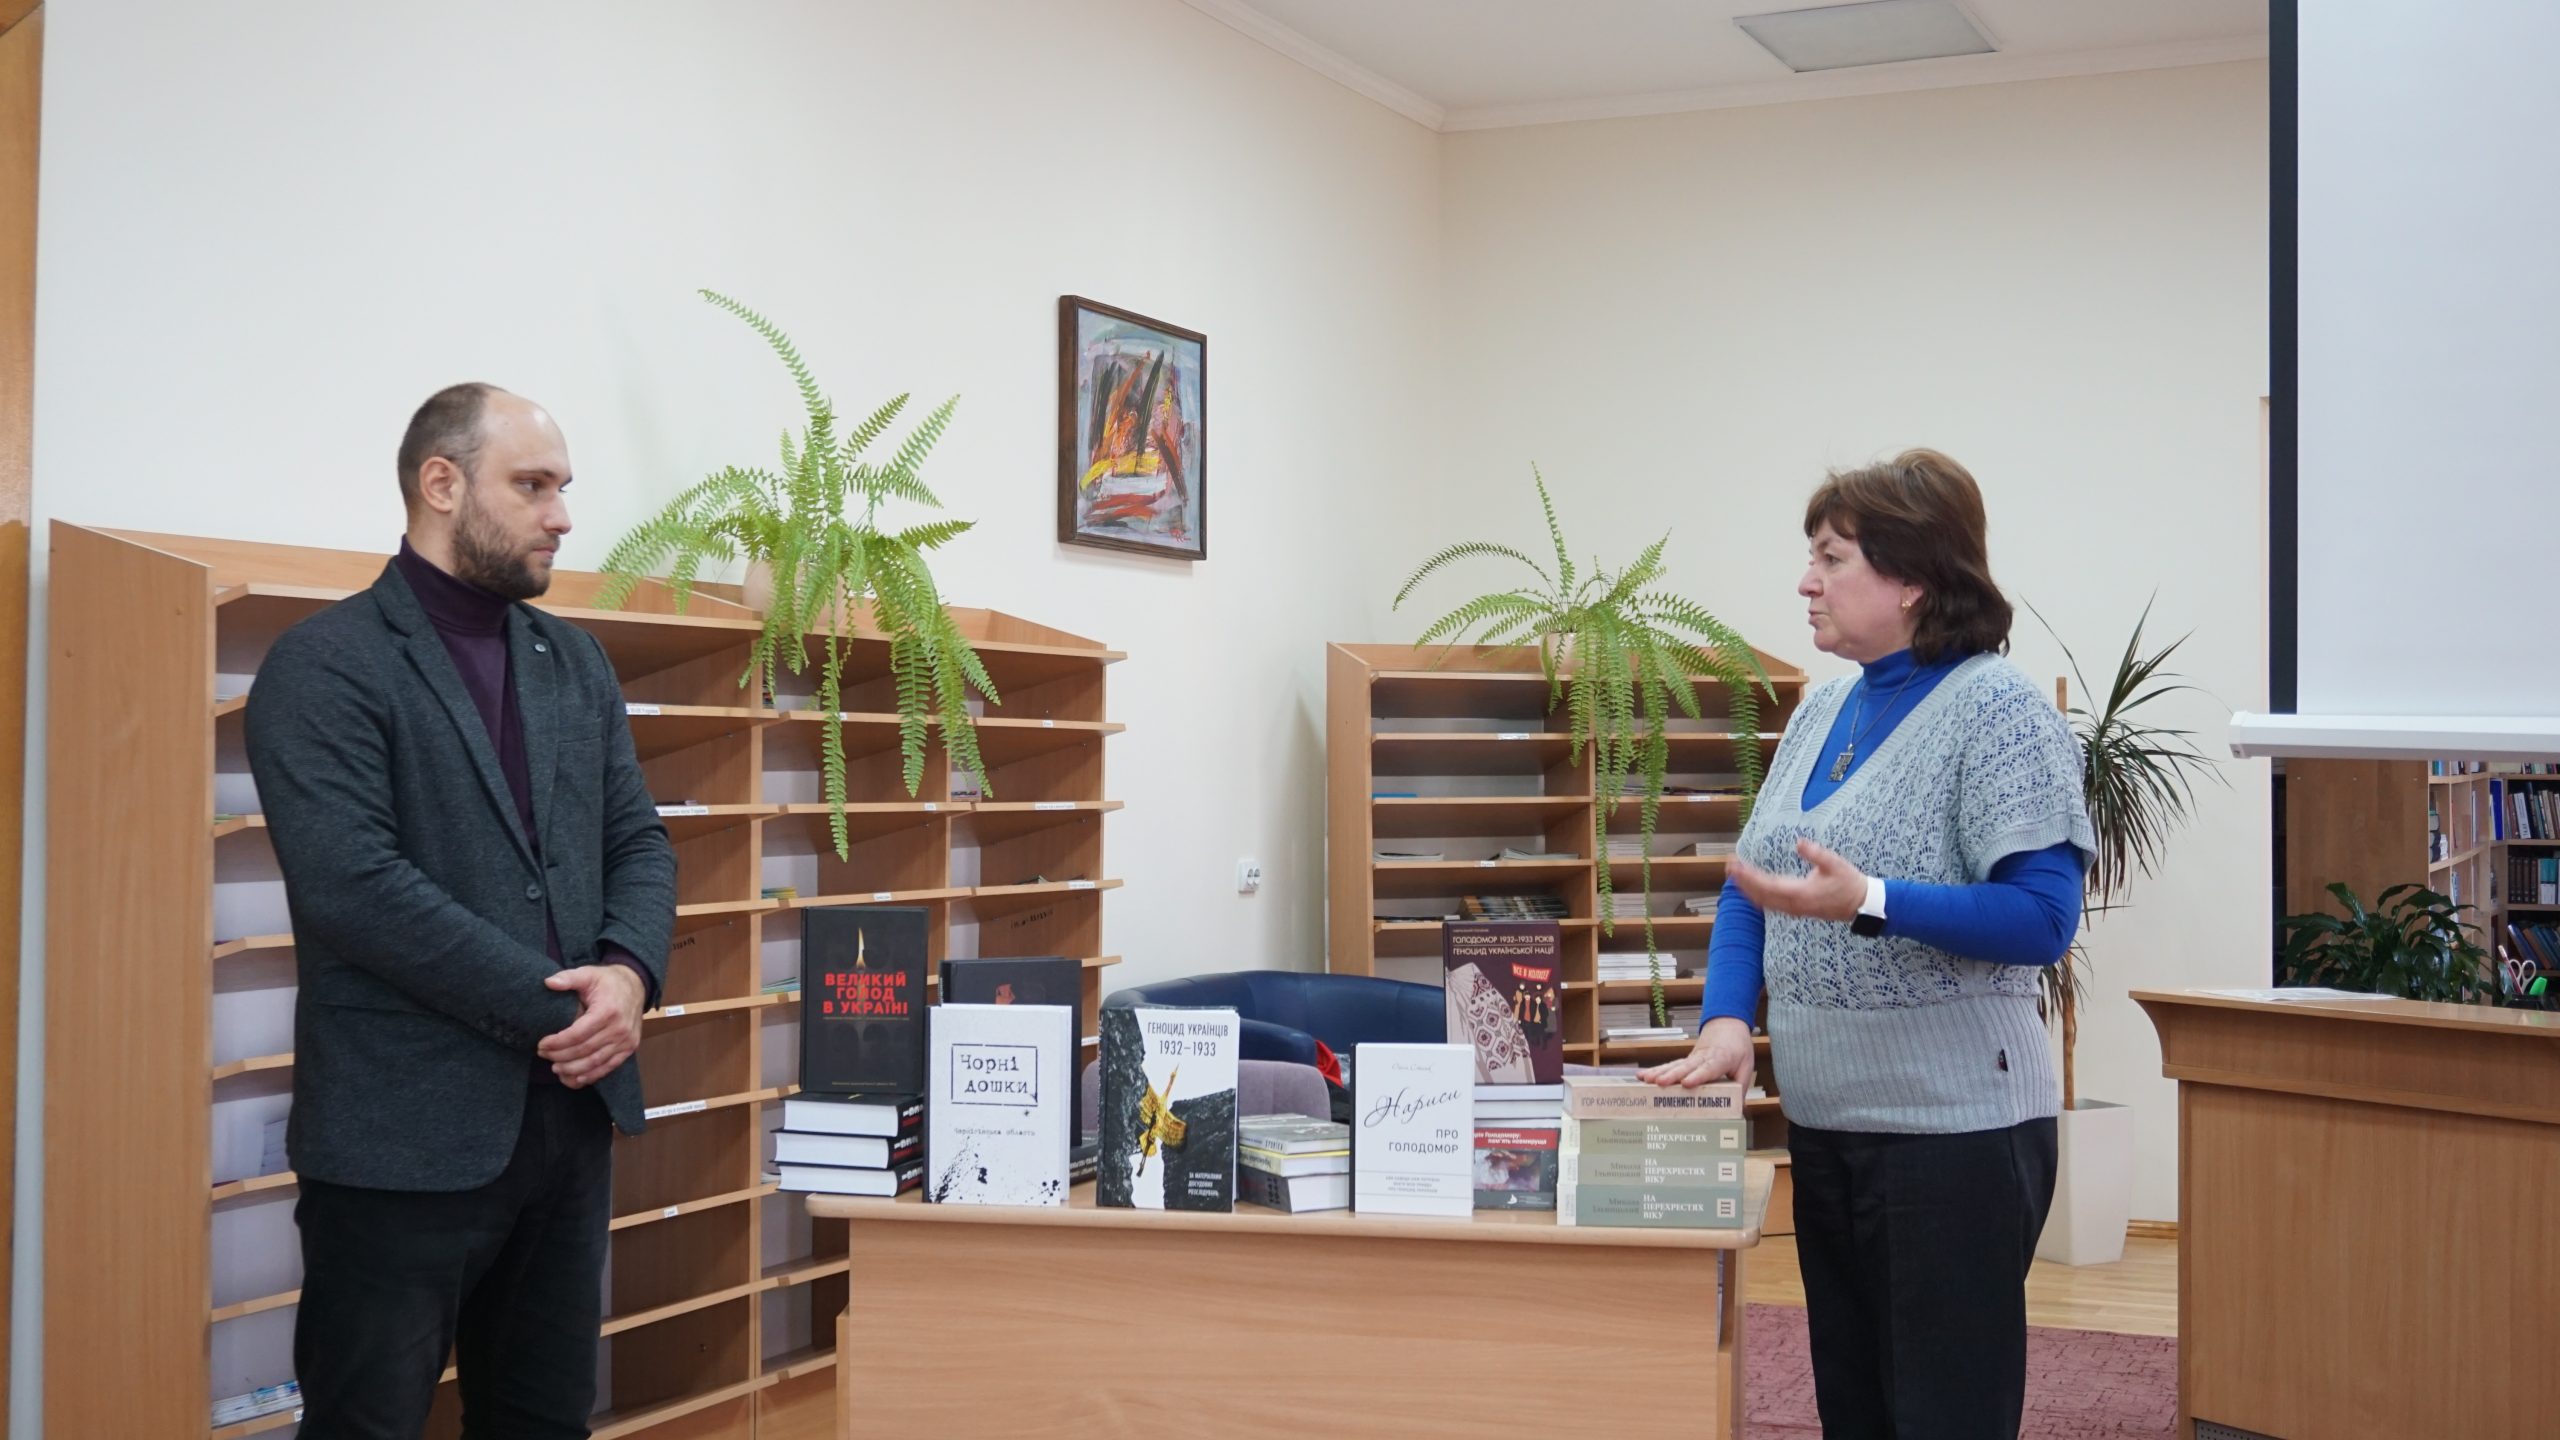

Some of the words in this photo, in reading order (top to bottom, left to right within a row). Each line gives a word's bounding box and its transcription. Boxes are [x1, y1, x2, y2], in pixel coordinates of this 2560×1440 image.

[1452, 935, 1497, 944] ГОЛОДОМОР
[1534, 935, 1554, 943] РОКІВ
[1453, 947, 1488, 956] ГЕНОЦИД
[1489, 946, 1533, 955] УКРАЇНСЬКОЇ
[1534, 945, 1554, 955] НАЦІЇ
[825, 971, 906, 987] ВЕЛИКИЙ
[837, 987, 895, 1002] ГОЛОД
[823, 1000, 834, 1014] В
[841, 1000, 908, 1015] УКРАЇНІ
[1147, 1022, 1184, 1036] ГЕНОЦИД
[1187, 1023, 1229, 1038] УКРАЇНЦІВ
[960, 1054, 1019, 1074] Чорні
[1581, 1097, 1595, 1107] ІГОР
[1596, 1096, 1647, 1107] КАЧУРОВСЬКИЙ
[1653, 1096, 1695, 1108] ПРОМЕНИСТІ
[1697, 1096, 1731, 1108] СИЛЬВЕТИ
[1364, 1086, 1463, 1129] Нариси
[1436, 1129, 1459, 1139] ПРО
[1647, 1125, 1660, 1133] НА
[1647, 1134, 1707, 1142] ПЕРЕХРЕСТЯХ
[1389, 1141, 1459, 1154] ГОЛОДОМОР
[1647, 1142, 1667, 1150] ВІКУ
[1645, 1158, 1657, 1166] НА
[1645, 1167, 1705, 1176] ПЕРЕХРЕСТЯХ
[1645, 1176, 1665, 1184] ВІКУ
[1643, 1194, 1656, 1202] НА
[1643, 1203, 1704, 1212] ПЕРЕХРЕСТЯХ
